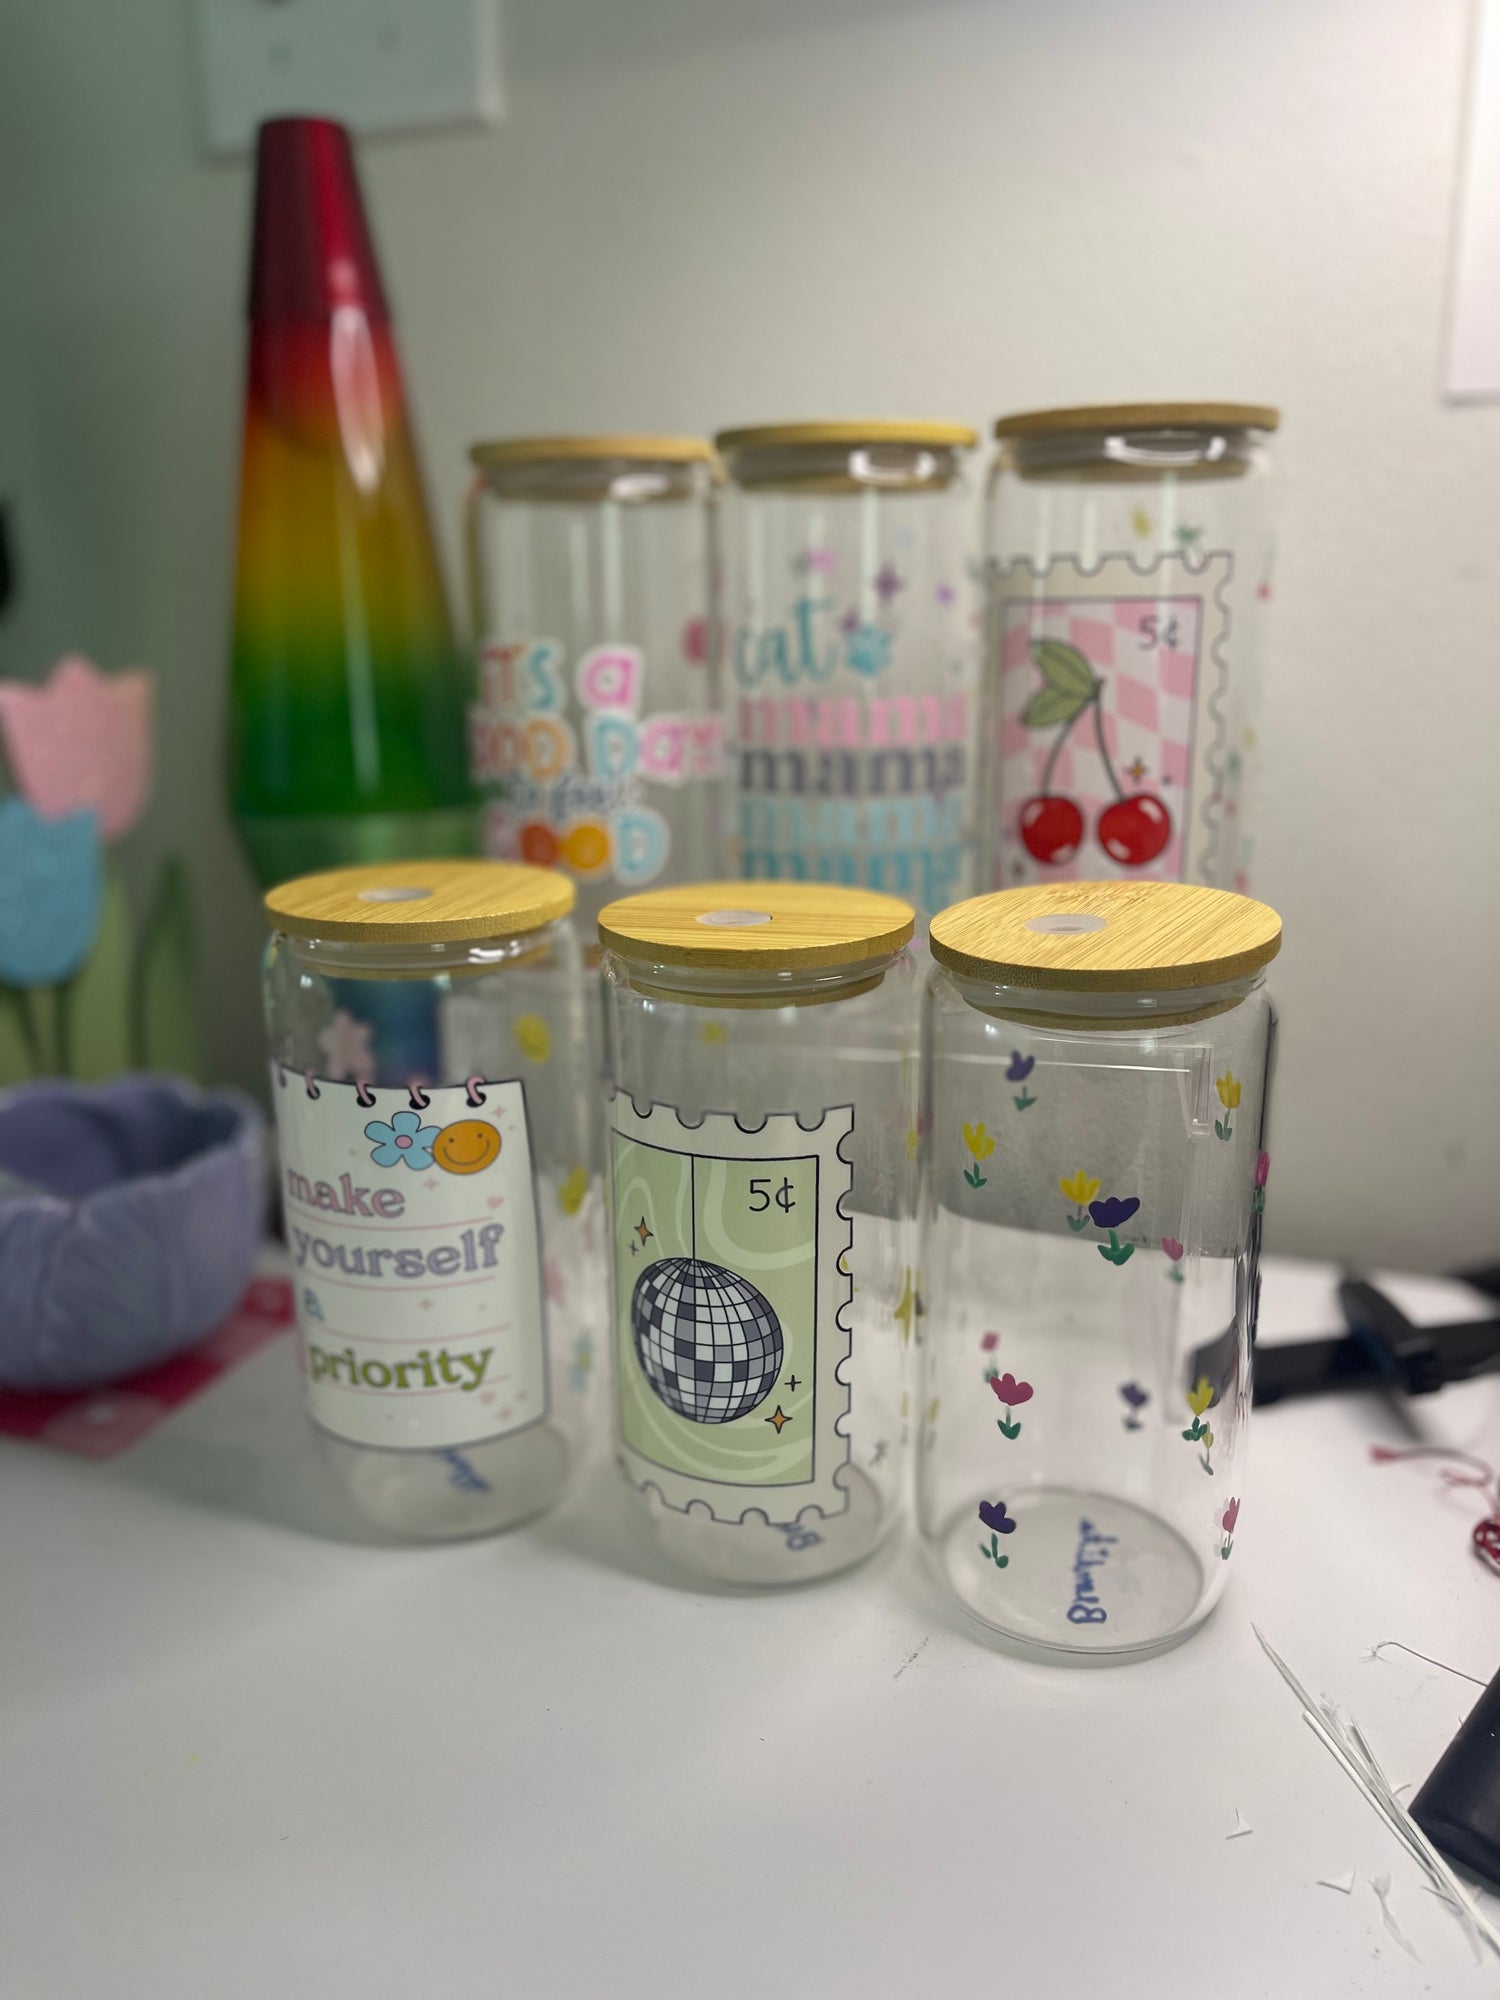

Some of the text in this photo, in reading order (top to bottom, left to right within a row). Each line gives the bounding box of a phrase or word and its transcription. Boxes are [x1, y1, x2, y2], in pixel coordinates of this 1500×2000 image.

[286, 1168, 406, 1219] make
[292, 1222, 506, 1280] yourself
[308, 1346, 494, 1392] priority
